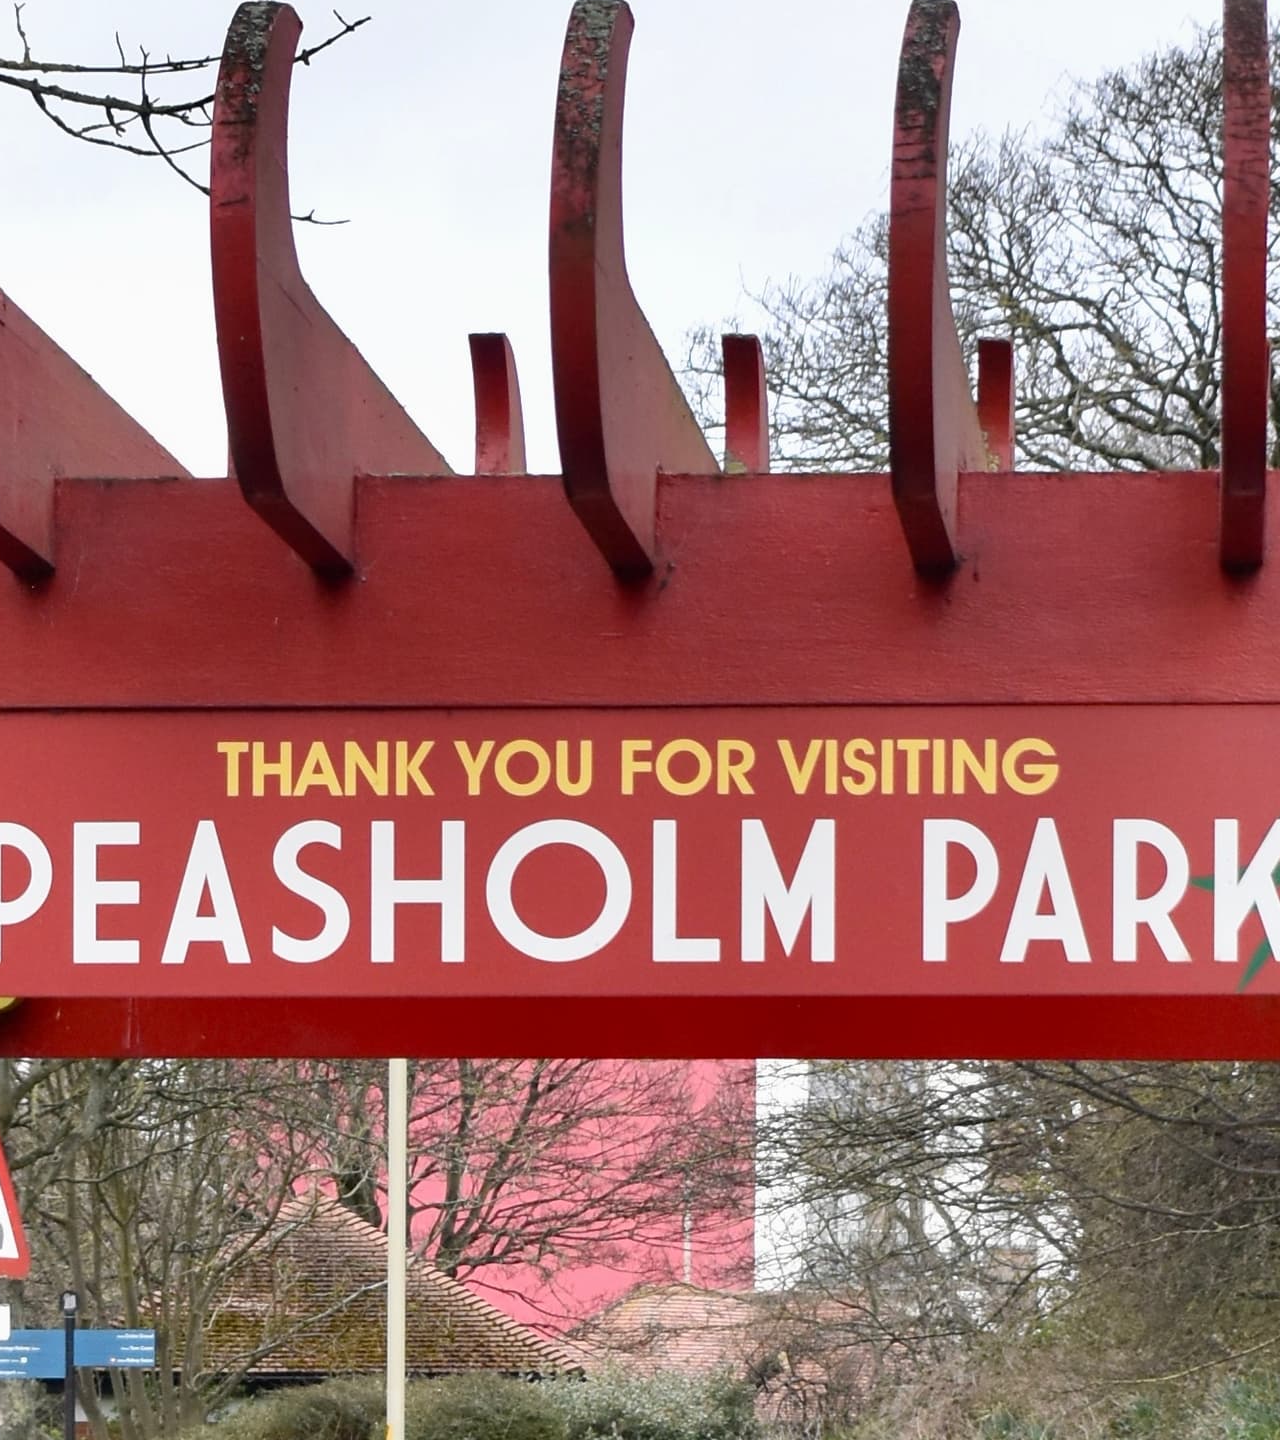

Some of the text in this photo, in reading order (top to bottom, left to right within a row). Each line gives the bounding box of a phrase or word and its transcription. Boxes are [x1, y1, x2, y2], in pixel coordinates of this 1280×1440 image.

[216, 737, 1060, 797] THANK YOU FOR VISITING
